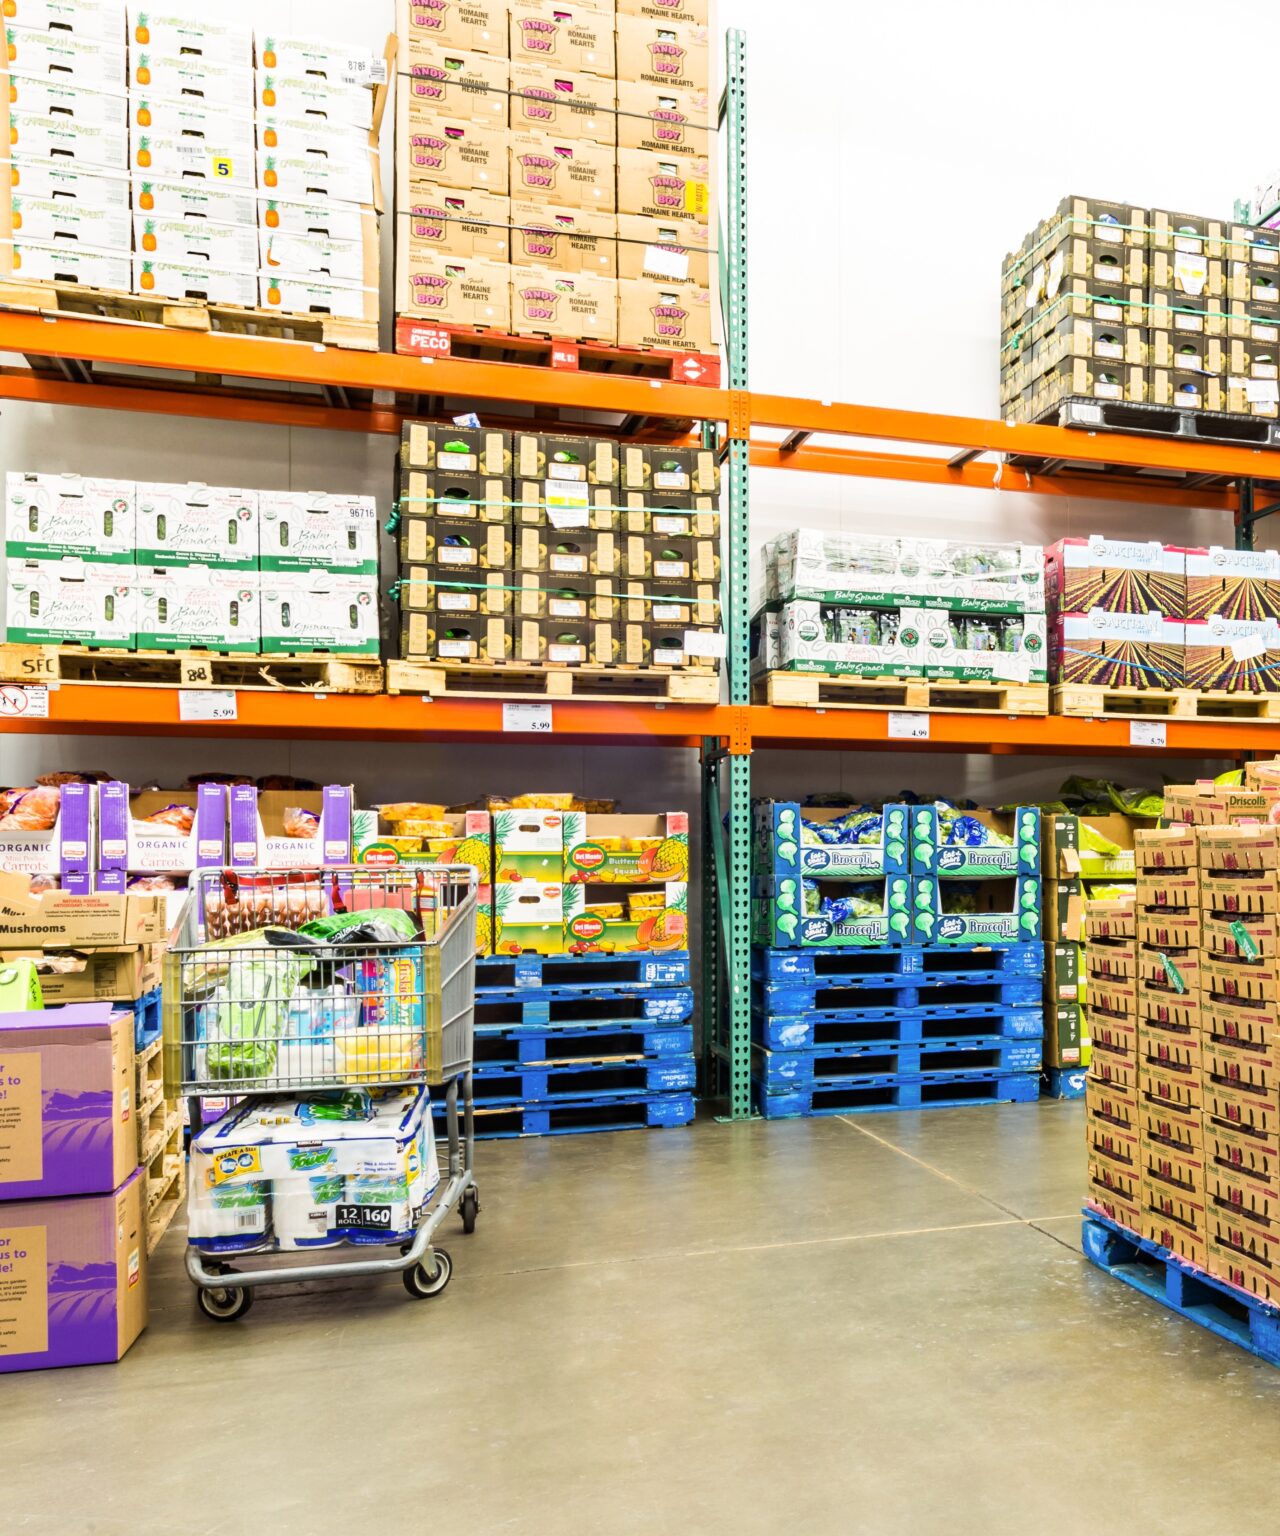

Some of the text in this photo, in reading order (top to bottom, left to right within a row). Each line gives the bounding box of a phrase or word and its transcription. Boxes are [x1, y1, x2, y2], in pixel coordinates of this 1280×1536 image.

[521, 21, 557, 33] ANDY
[567, 31, 596, 41] ROMAINE
[526, 39, 552, 50] BOY
[570, 39, 595, 49] HEARTS
[641, 74, 694, 87] ROMAINE HEARTS
[411, 134, 447, 149] ANDY
[459, 148, 489, 158] ROMAINE
[415, 155, 441, 167] BOY
[461, 155, 487, 164] HEARTS
[218, 163, 229, 175] 5
[412, 274, 448, 287] ANDY
[460, 284, 491, 294] ROMAINE
[417, 294, 443, 305] BOY
[463, 291, 489, 300] HEARTS
[655, 307, 686, 319] ANDY
[658, 325, 682, 336] BOY
[410, 336, 448, 350] PECO
[643, 337, 696, 349] ROMAINE HEARTS
[349, 508, 374, 518] 96716
[834, 591, 885, 604] Baby Spinach
[961, 599, 1008, 612] Baby Spinach
[834, 662, 885, 675] Baby Spinach
[212, 708, 234, 718] 5.99
[531, 722, 550, 730] 5.99
[912, 729, 927, 737] 4.99
[1230, 796, 1266, 806] Driscoll's
[137, 840, 190, 849] ORGANIC
[266, 842, 315, 850] ORGANIC
[140, 856, 185, 867] Carrots
[832, 853, 871, 865] Broccoli
[969, 852, 1011, 865] Broccoli
[2, 861, 48, 872] Carrots
[0, 924, 66, 933] Mushrooms
[836, 923, 880, 935] Broccoli
[969, 920, 1011, 933] Broccoli
[8, 1077, 21, 1085] to
[291, 1148, 334, 1170] Towel
[341, 1208, 390, 1222] 12 160
[14, 1250, 27, 1258] to
